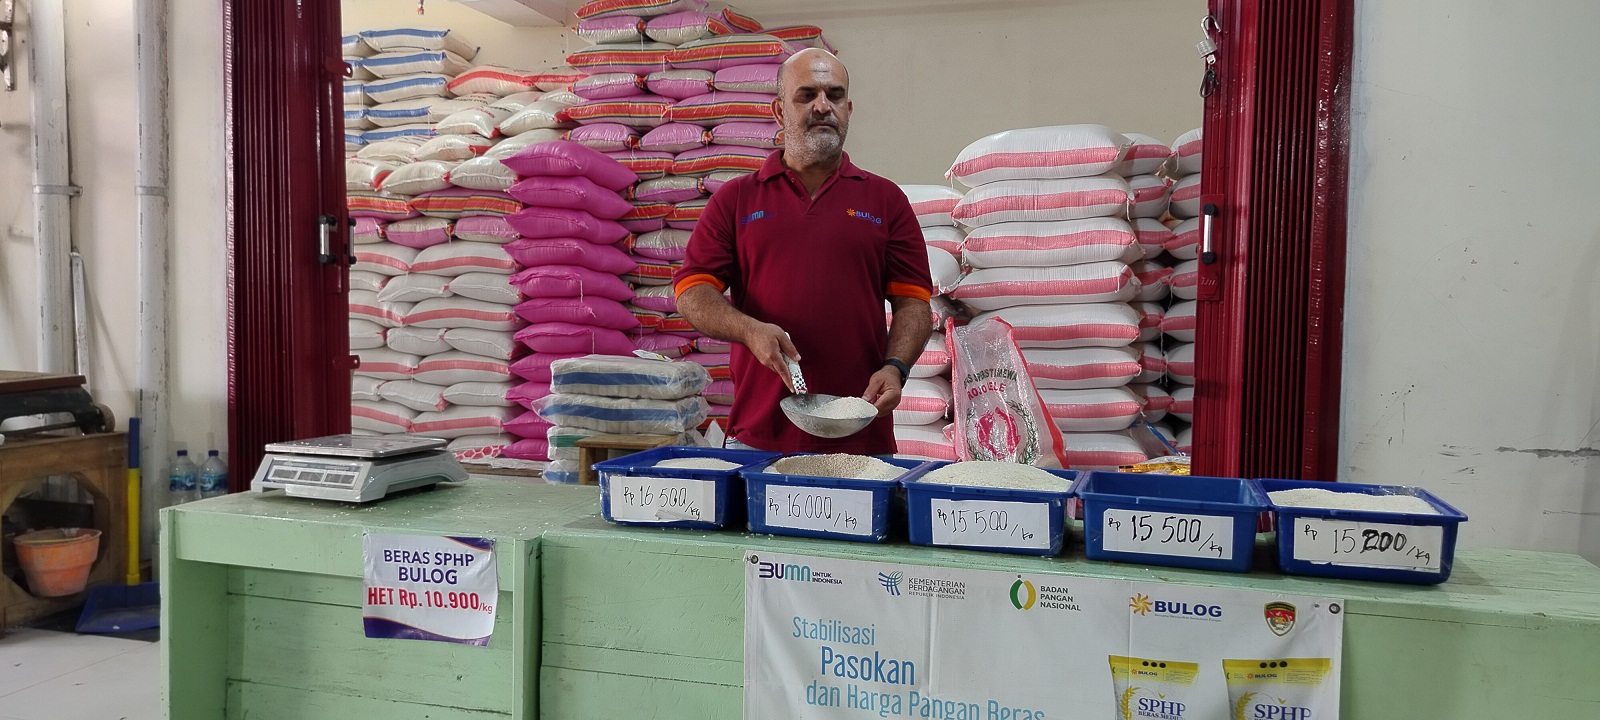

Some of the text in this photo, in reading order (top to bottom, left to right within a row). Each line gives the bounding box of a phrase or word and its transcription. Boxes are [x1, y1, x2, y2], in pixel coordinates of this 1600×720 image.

[855, 210, 882, 224] BULOG
[624, 486, 635, 506] Rp
[769, 497, 780, 516] Rp
[936, 508, 948, 526] Rp
[1108, 517, 1121, 532] Rp
[1304, 524, 1318, 541] Rp
[383, 549, 475, 566] BERAS SPHP
[398, 566, 458, 585] BULOG
[908, 577, 966, 589] KEMENTERIAN
[367, 587, 395, 606] HET
[908, 584, 966, 595] PERDAGANGAN
[908, 590, 935, 598] REPUBLIK
[1040, 585, 1069, 594] BADAN
[1040, 593, 1074, 602] PANGAN
[1040, 601, 1082, 612] NASIONAL
[1154, 600, 1222, 618] BULOG
[792, 616, 875, 646] Stabilisasi
[821, 645, 915, 685] Pasokan
[806, 680, 1045, 720] dan Harga Pangan Beras
[1138, 697, 1186, 717] SPHP
[1138, 710, 1159, 719] BERAS
[1254, 703, 1312, 720] SPHP
